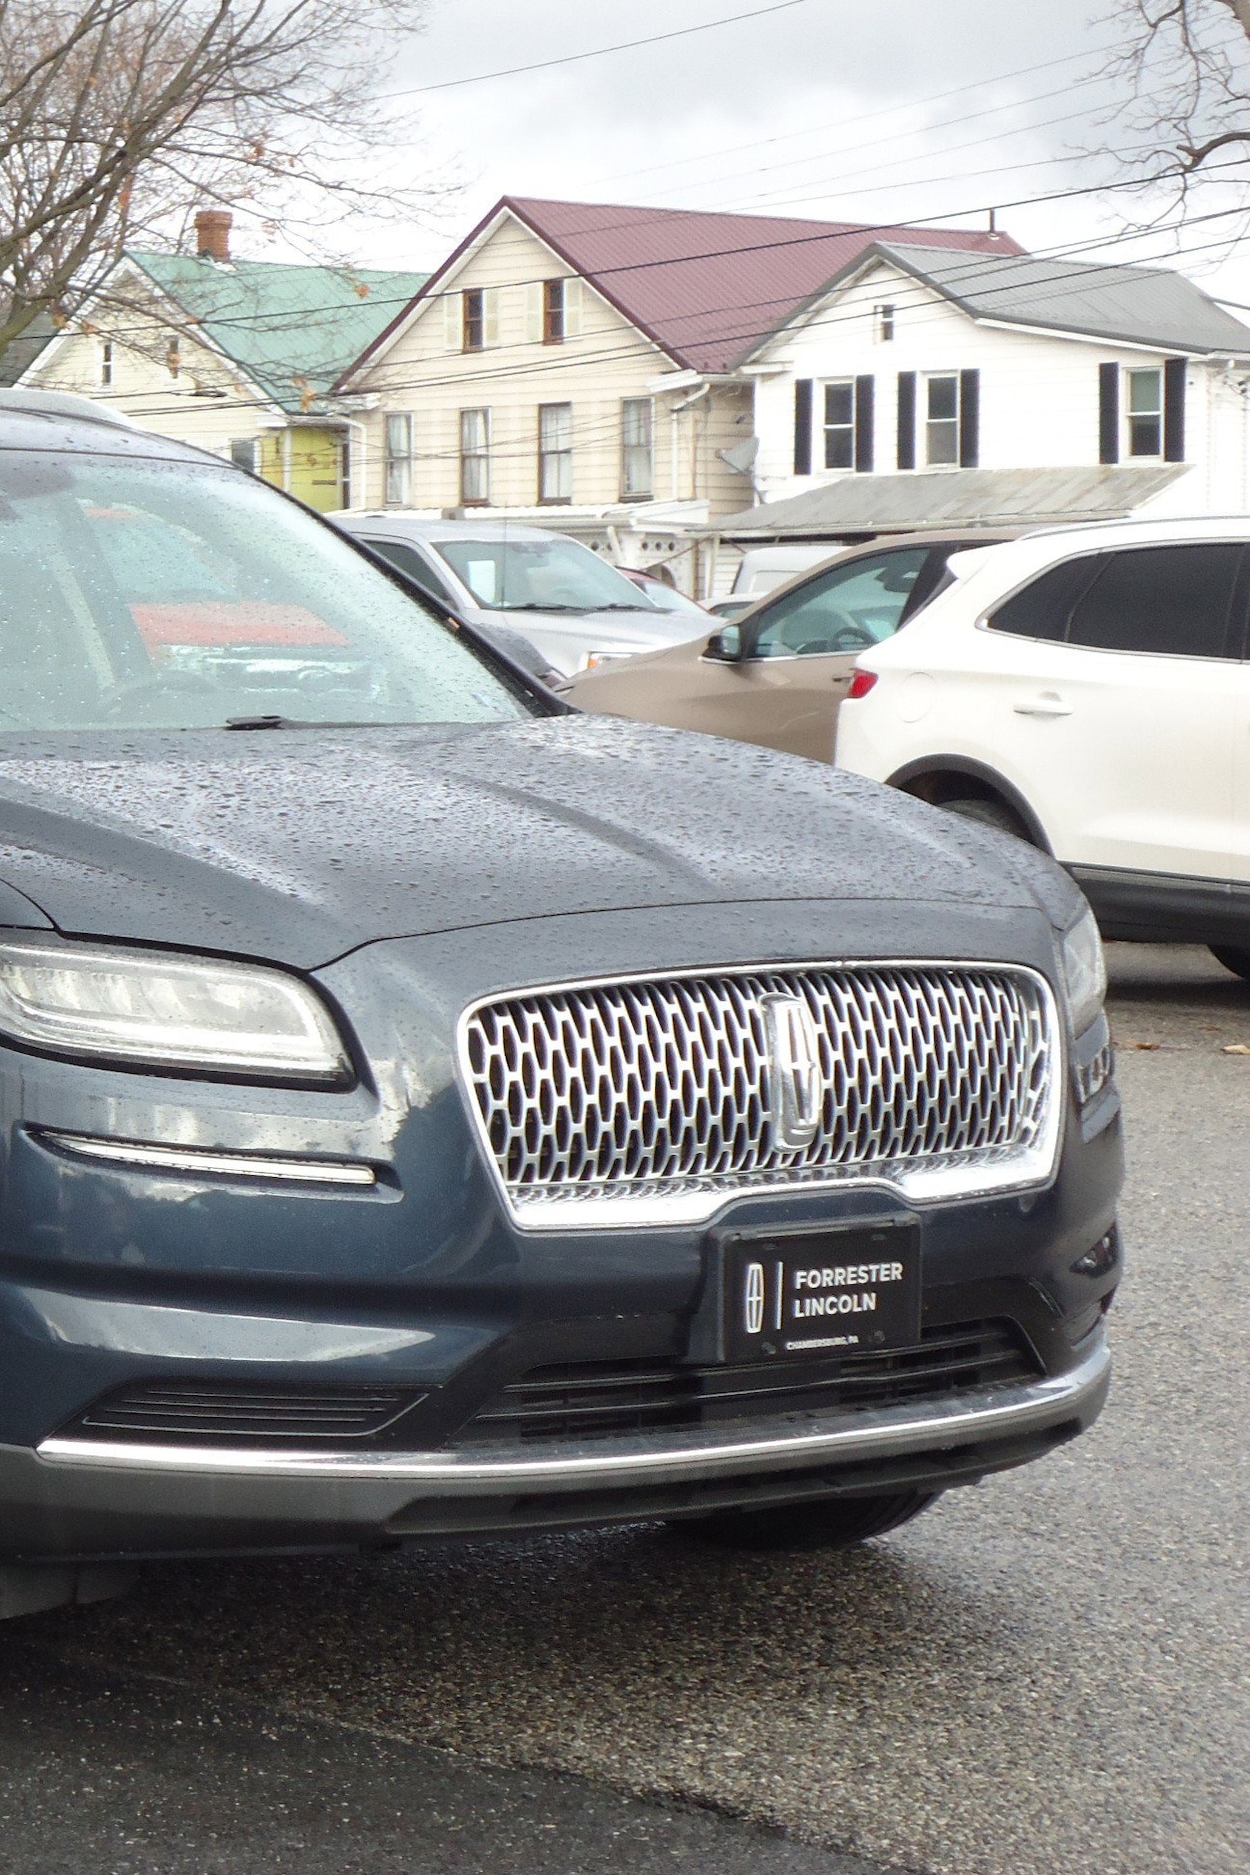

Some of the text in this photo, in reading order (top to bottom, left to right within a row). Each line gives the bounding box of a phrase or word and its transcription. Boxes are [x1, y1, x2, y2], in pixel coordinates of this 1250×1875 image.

[795, 1262, 903, 1289] FORRESTER
[794, 1293, 876, 1318] LINCOLN
[848, 1335, 859, 1344] PA
